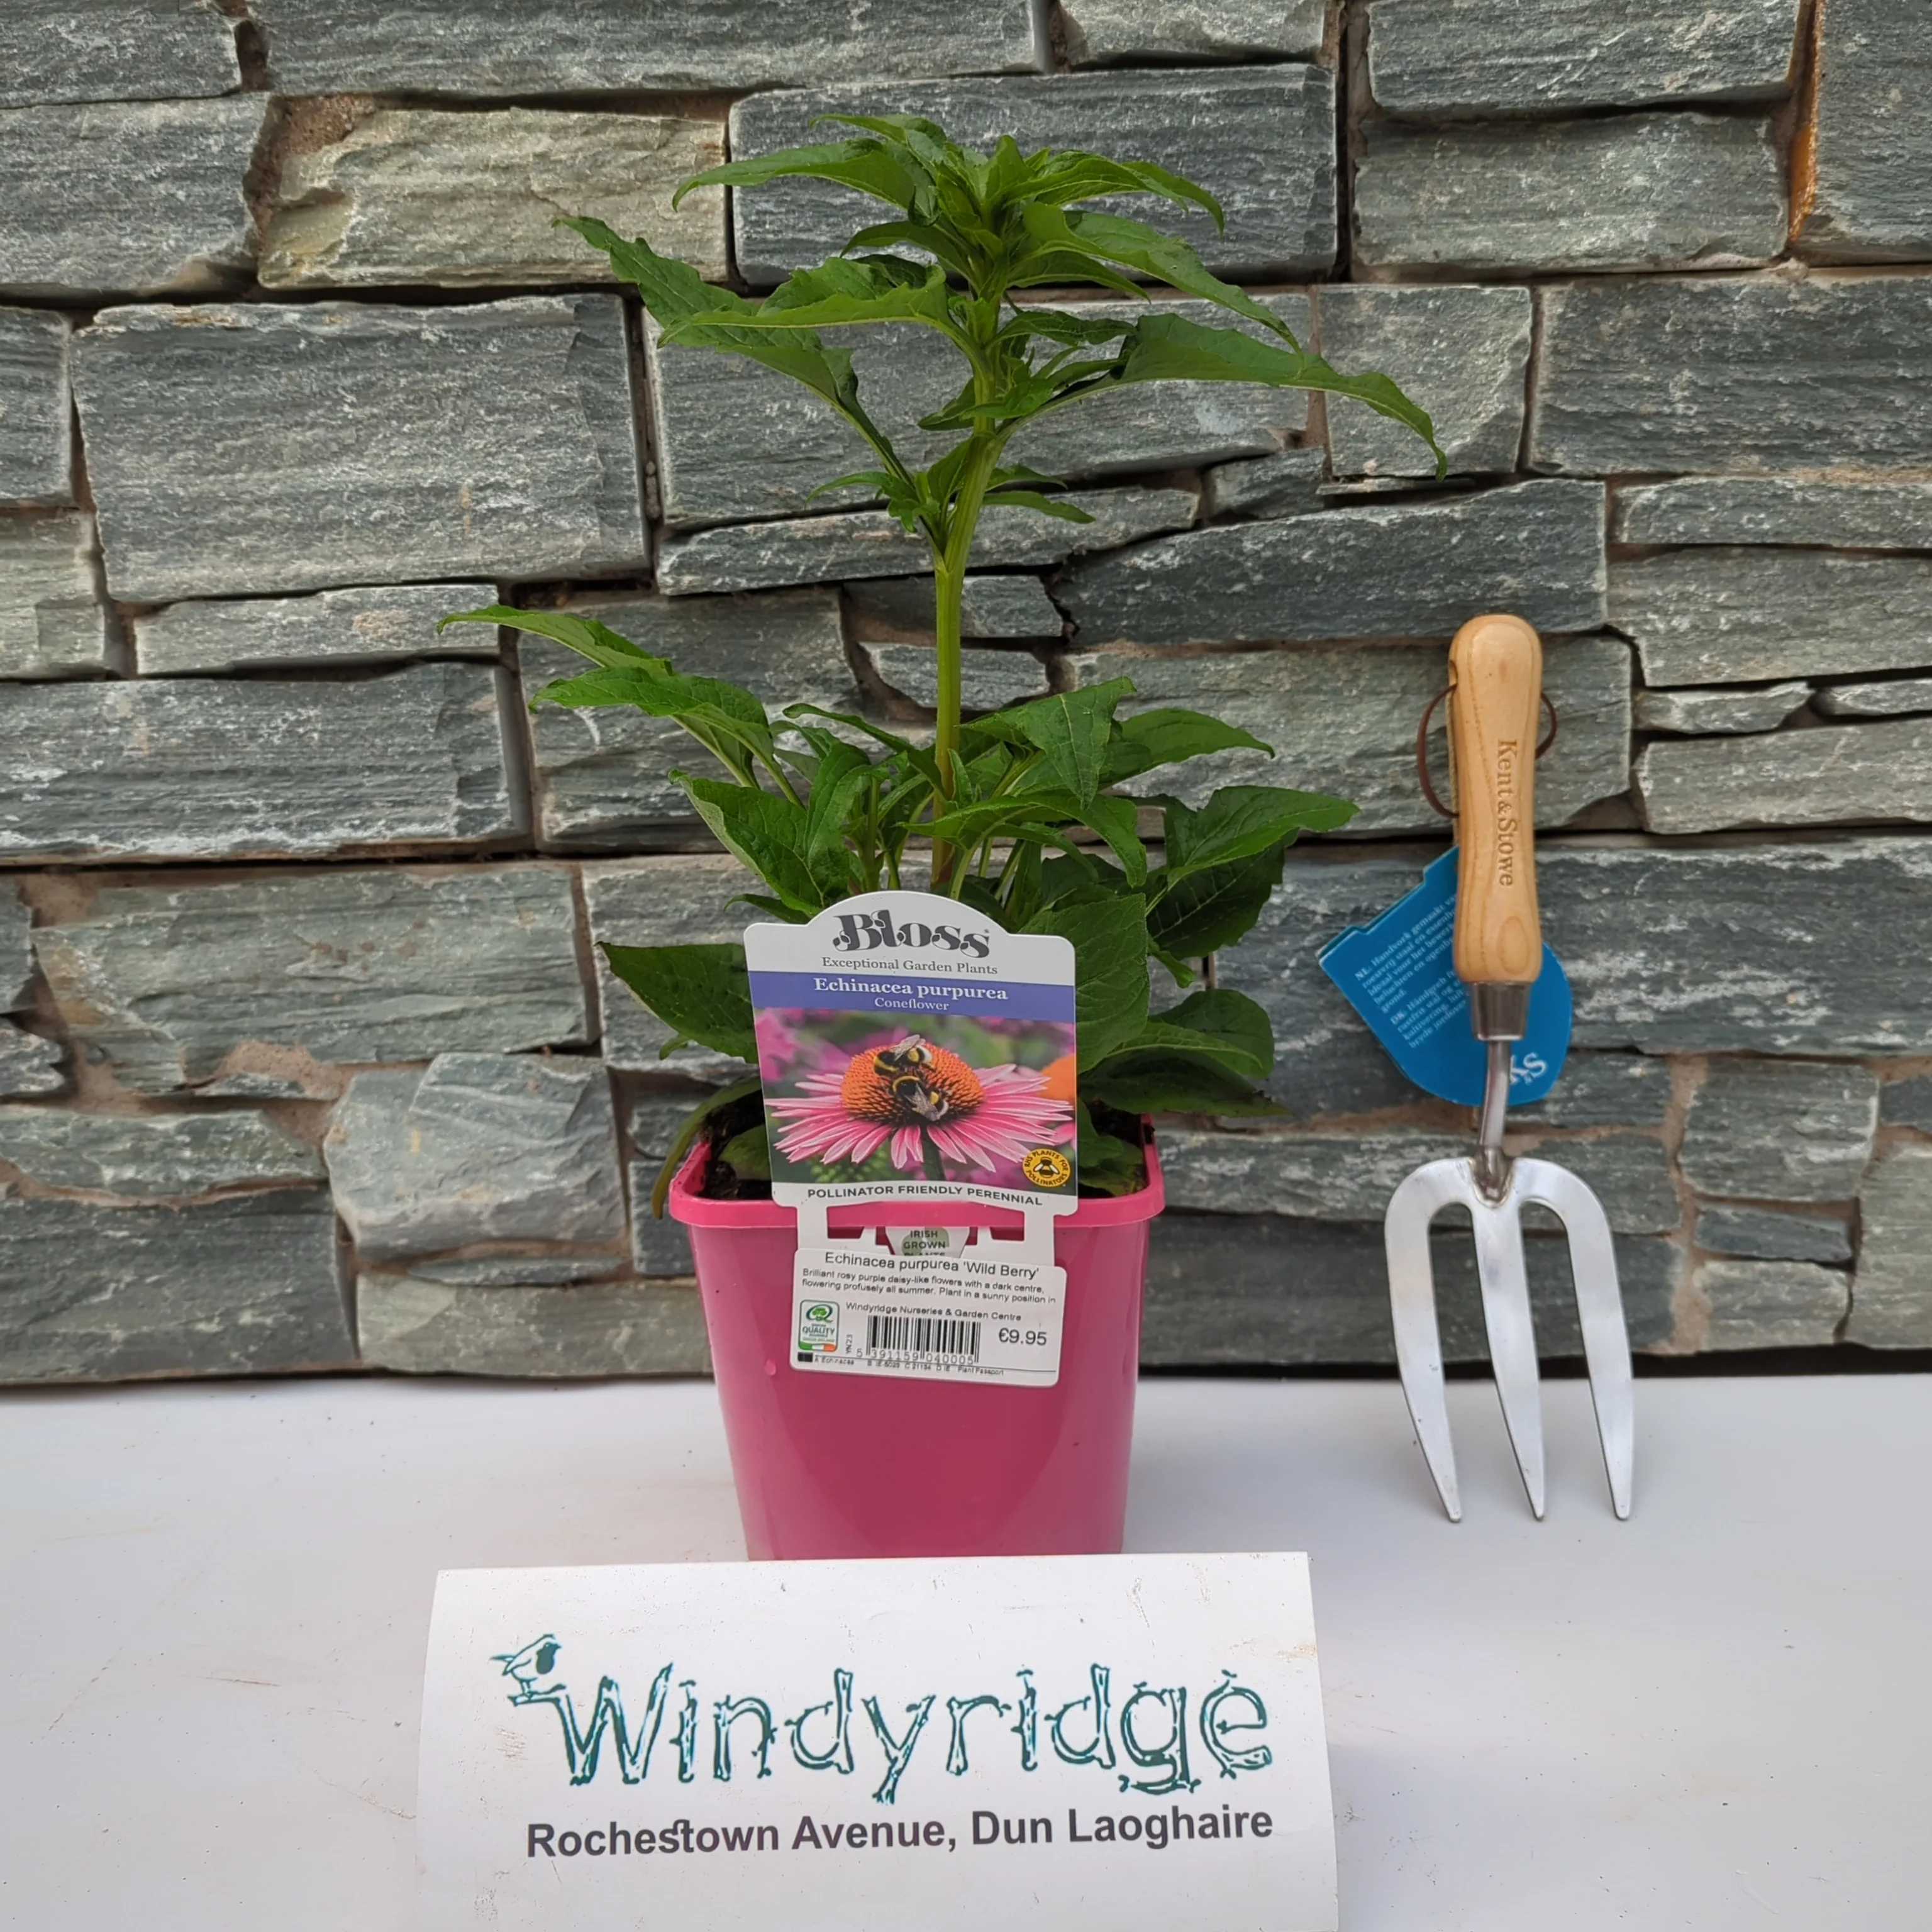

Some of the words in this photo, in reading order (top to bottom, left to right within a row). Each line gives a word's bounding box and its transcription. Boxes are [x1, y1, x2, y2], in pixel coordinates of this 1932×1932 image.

[1497, 739, 1518, 798] Kent
[1497, 818, 1518, 887] Stowe
[833, 909, 990, 958] Bloss
[821, 957, 899, 970] Exceptional
[903, 960, 952, 972] Garden
[957, 962, 997, 974] Plants
[813, 977, 913, 994] Echinacea
[918, 985, 1008, 1000] purpurea
[875, 997, 949, 1011] Coneflower
[1024, 1156, 1033, 1167] RHS
[1032, 1150, 1060, 1159] PLANTS
[1059, 1159, 1069, 1171] FOR
[1026, 1170, 1067, 1185] POLLINATORS
[808, 1186, 893, 1198] POLLINATOR
[898, 1185, 963, 1195] FRIENDLY
[967, 1188, 1043, 1206] PERENNIAL
[825, 1252, 895, 1269] Echinacea
[899, 1259, 958, 1272] purpurea
[963, 1261, 996, 1275] 'Wild
[1001, 1265, 1039, 1280] Berry'
[803, 1268, 835, 1278] Brilliant
[837, 1272, 855, 1281] rosy
[858, 1274, 886, 1283] purple
[888, 1275, 929, 1285] daisy-like
[931, 1275, 962, 1285] flowers
[965, 1280, 982, 1289] with
[992, 1282, 1011, 1291] dark
[1014, 1285, 1044, 1294] centre,
[802, 1279, 841, 1290] flowering
[843, 1283, 883, 1294] profusely
[899, 1287, 936, 1296] summer.
[939, 1287, 962, 1297] Plant
[982, 1292, 1009, 1302] sunny
[1012, 1294, 1045, 1304] position
[846, 1302, 897, 1314] Windyridge
[900, 1306, 942, 1315] Nurseries
[955, 1309, 989, 1319] Garden
[991, 1312, 1021, 1321] Centre
[802, 1326, 835, 1335] QUALITY
[999, 1328, 1047, 1346] €9.95
[856, 1348, 863, 1358] 5
[872, 1349, 919, 1361] 391159
[926, 1353, 974, 1365] 040005
[508, 1662, 1272, 1805] Windyridge
[528, 1819, 779, 1857] Rochestown
[791, 1816, 956, 1852] Avenue,
[972, 1810, 1052, 1845] Dun
[1069, 1804, 1273, 1850] Laoghaire
